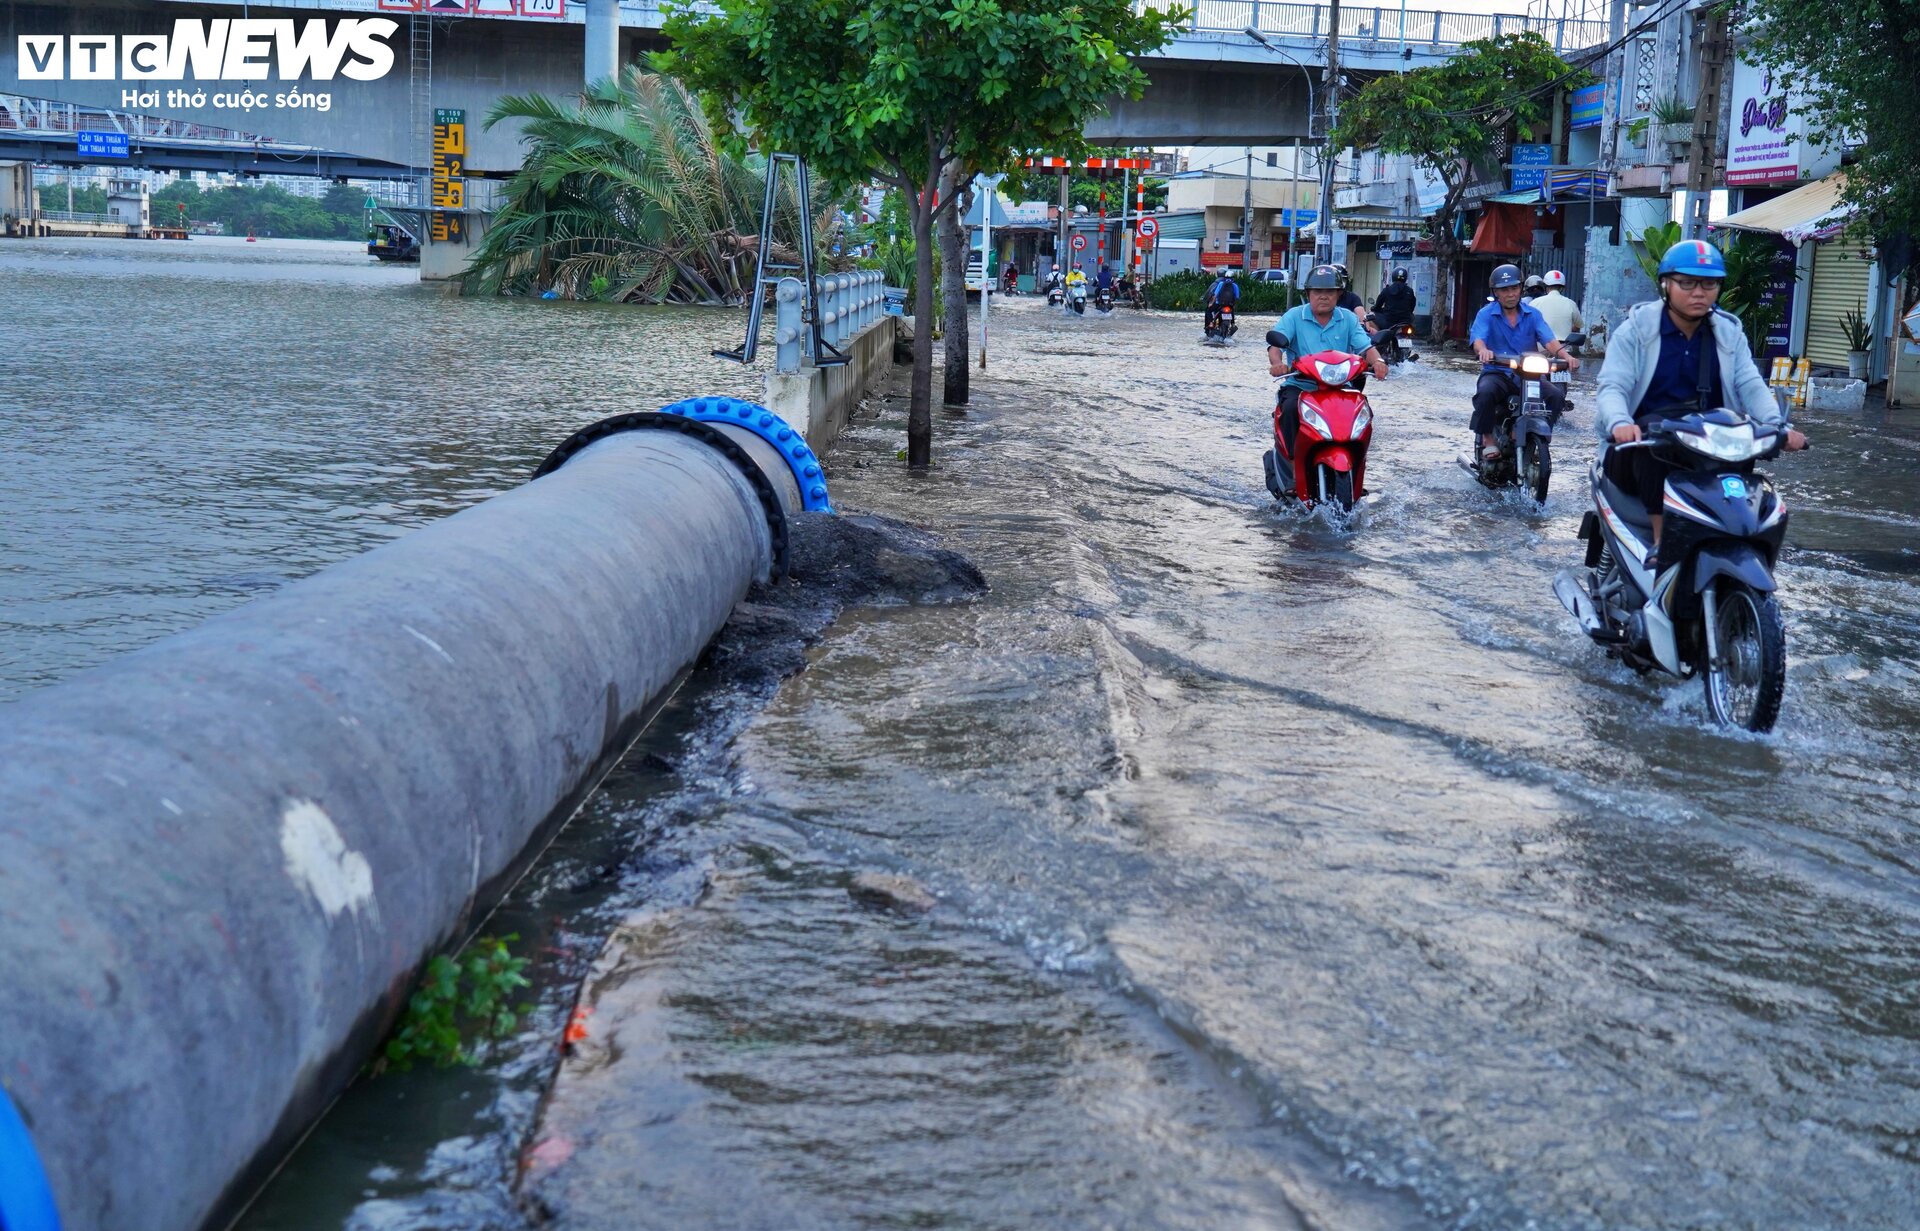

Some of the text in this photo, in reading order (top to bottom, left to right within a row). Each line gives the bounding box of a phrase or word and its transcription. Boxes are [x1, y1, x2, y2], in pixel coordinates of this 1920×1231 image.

[452, 131, 459, 146] 1
[90, 145, 105, 153] THUAN
[111, 146, 128, 154] BRIDGE
[451, 160, 461, 177] 2
[451, 189, 460, 205] 3
[450, 218, 459, 234] 4
